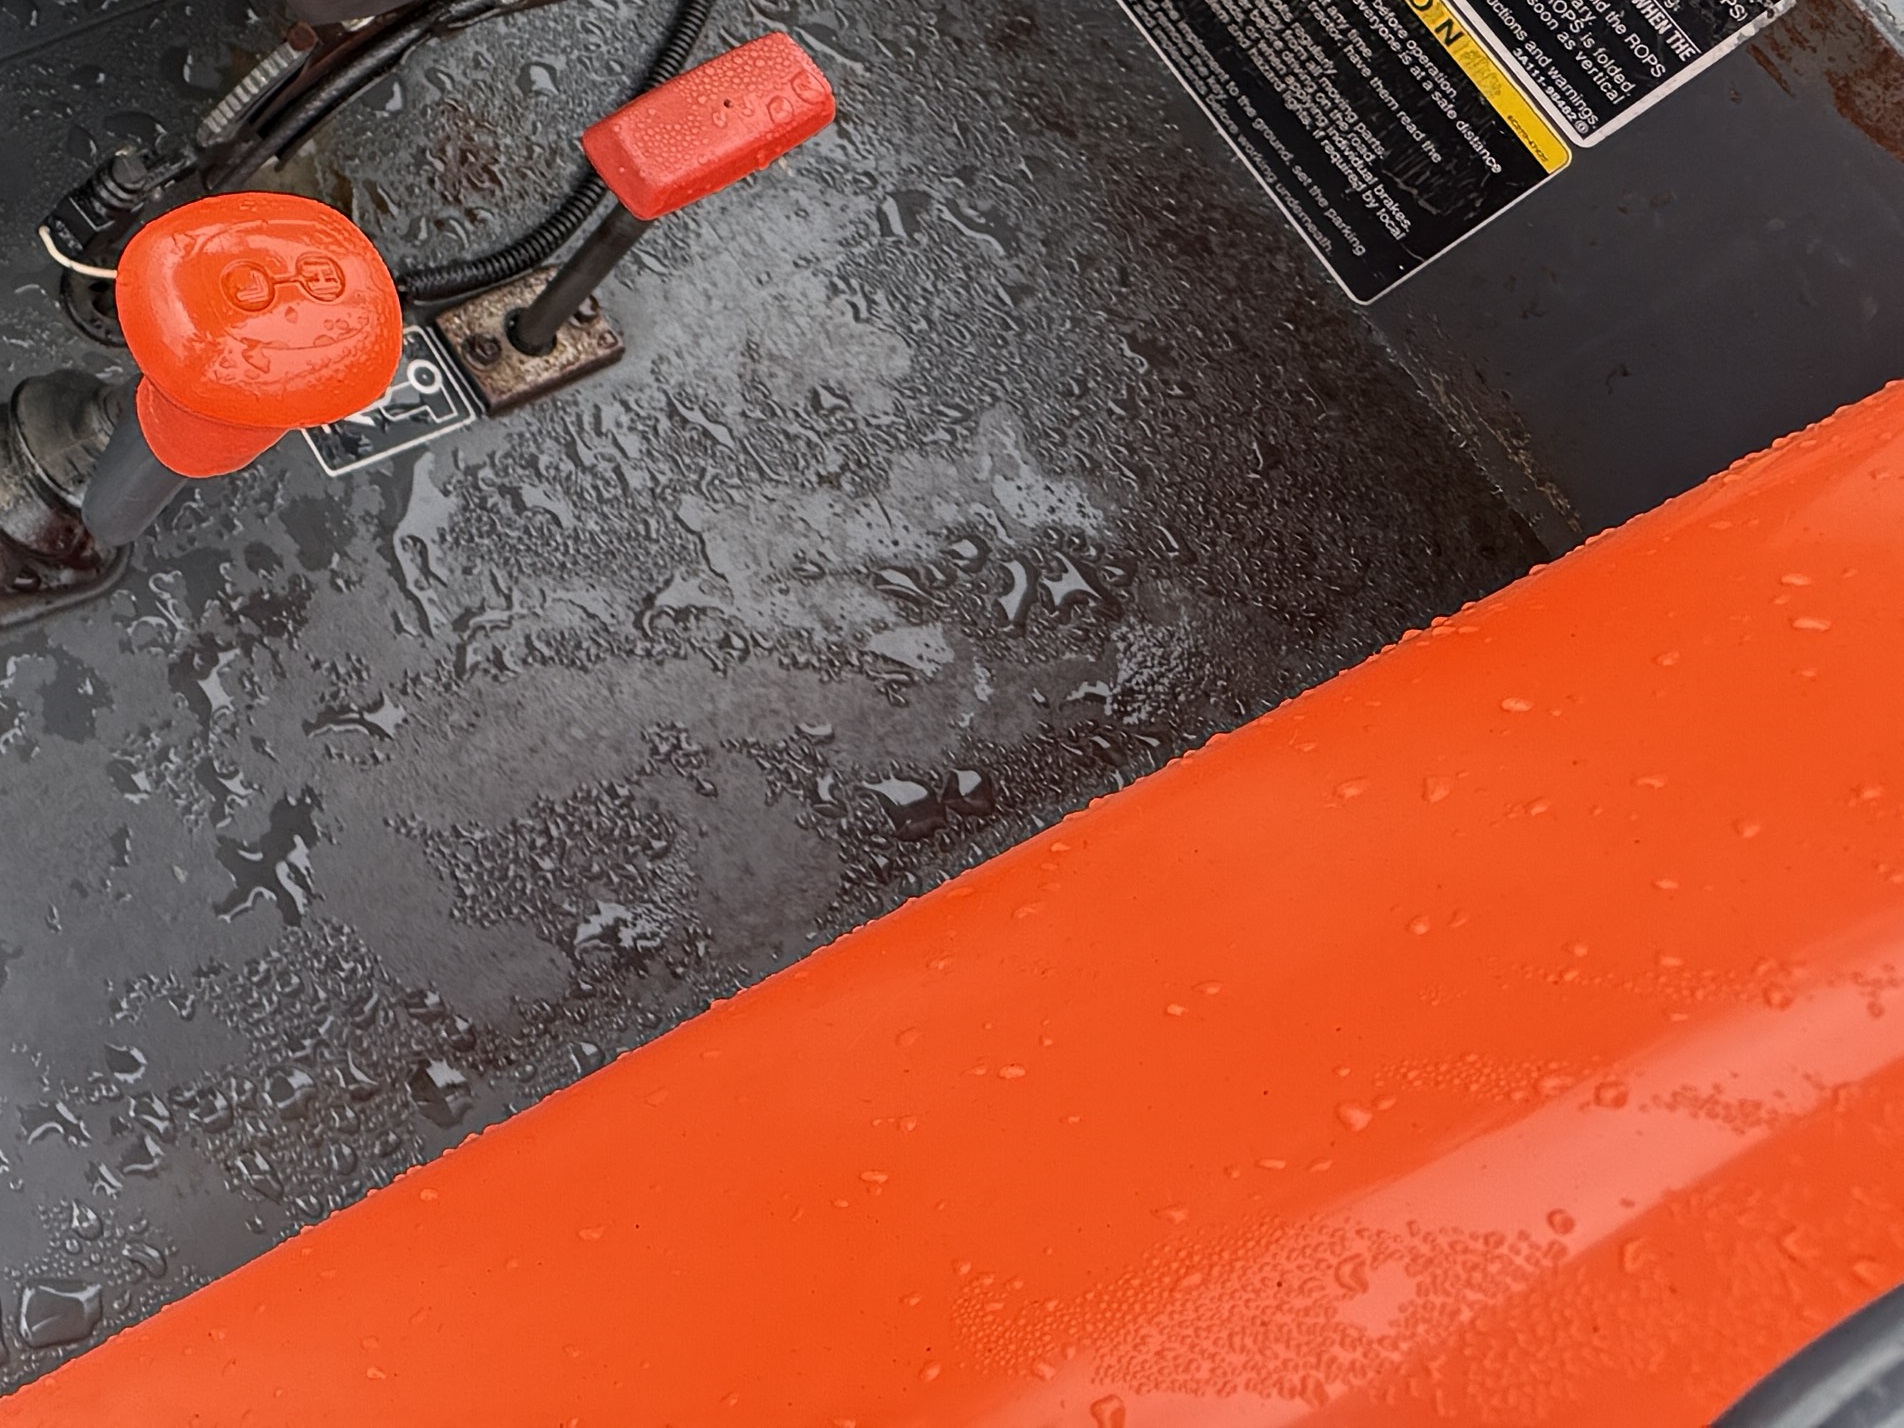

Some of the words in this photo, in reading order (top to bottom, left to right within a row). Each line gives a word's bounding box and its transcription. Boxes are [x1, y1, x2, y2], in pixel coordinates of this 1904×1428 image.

[1402, 36, 1463, 104] operation.
[1556, 30, 1576, 51] as
[1573, 48, 1624, 105] vertical
[1579, 31, 1597, 49] is
[1591, 46, 1638, 97] folded.
[1604, 10, 1630, 36] the
[1623, 32, 1667, 79] ROPS
[1664, 30, 1695, 61] THE
[1342, 44, 1373, 78] have
[1368, 75, 1400, 111] them
[1395, 109, 1426, 142] read
[1420, 139, 1444, 164] the
[1397, 48, 1415, 66] is
[1408, 62, 1427, 80] at
[1421, 78, 1434, 91] a
[1430, 88, 1460, 121] safe
[1454, 117, 1505, 175] distance
[1523, 38, 1551, 68] and
[1543, 64, 1603, 131] warnings.
[1324, 124, 1378, 186] individual
[1372, 183, 1416, 233] brakes.
[1358, 189, 1380, 211] by
[1375, 207, 1406, 241] local
